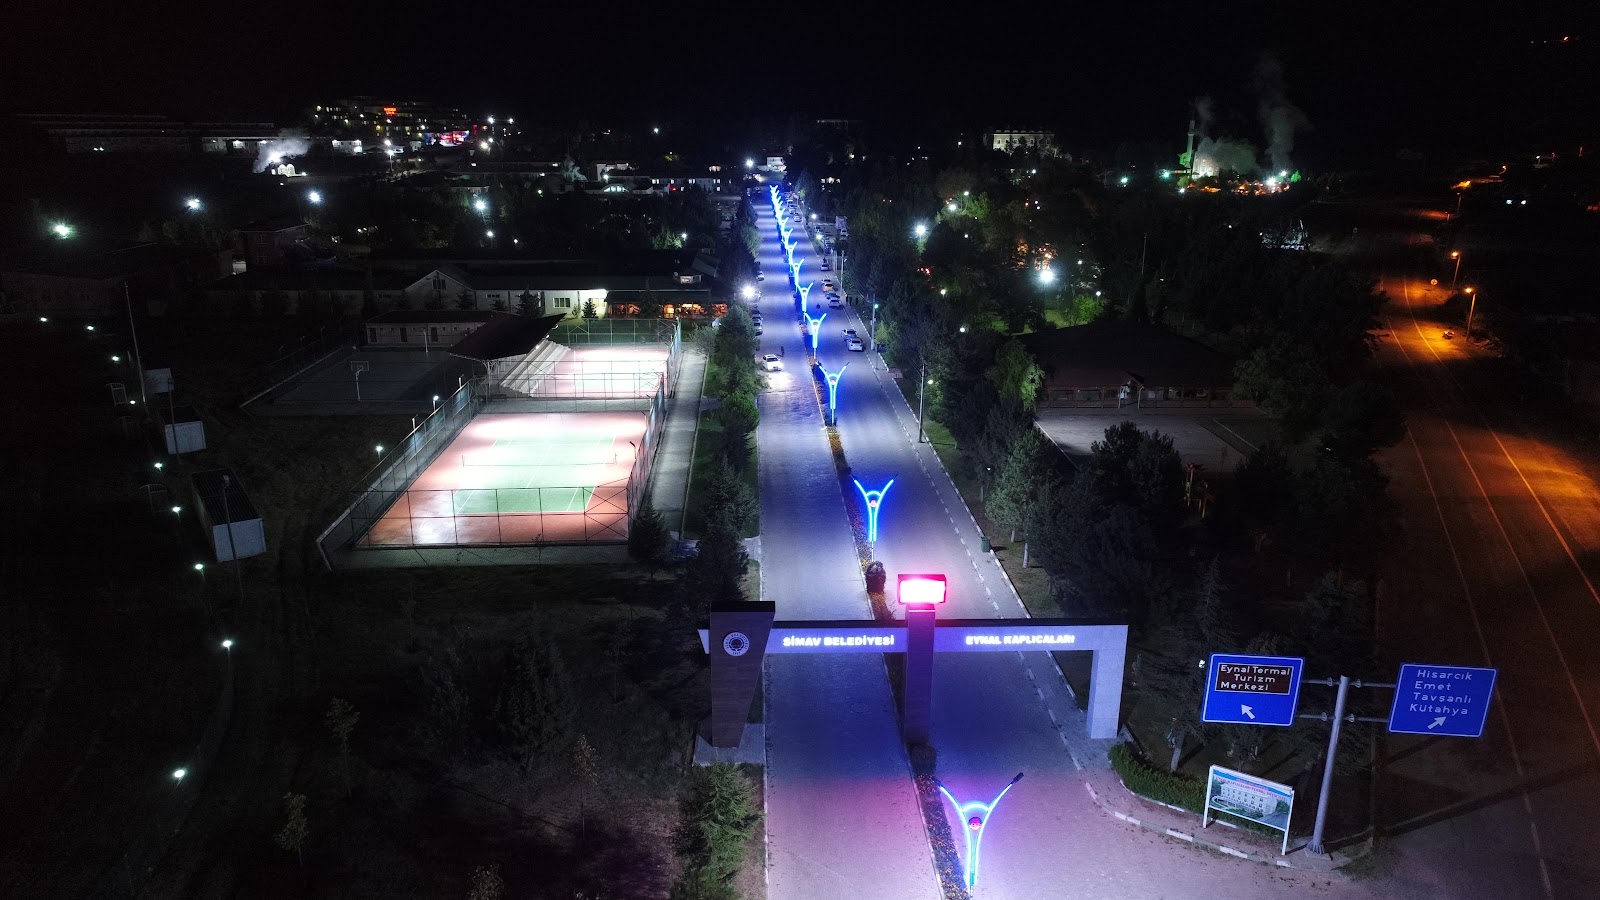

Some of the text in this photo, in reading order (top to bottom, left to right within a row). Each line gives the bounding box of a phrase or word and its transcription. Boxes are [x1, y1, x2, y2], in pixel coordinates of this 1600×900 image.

[783, 634, 895, 647] SİMAV BELEDİYESİ
[965, 634, 1076, 645] EYNAL KAPLICALARI
[1220, 664, 1290, 676] Eynal Termal
[1416, 669, 1473, 681] Hisarcık
[1233, 673, 1276, 683] Turizm
[1220, 681, 1269, 691] Merkezi
[1414, 680, 1452, 691] Emet
[1413, 691, 1472, 704] Tavşanlı
[1409, 703, 1469, 717] Kütahya
